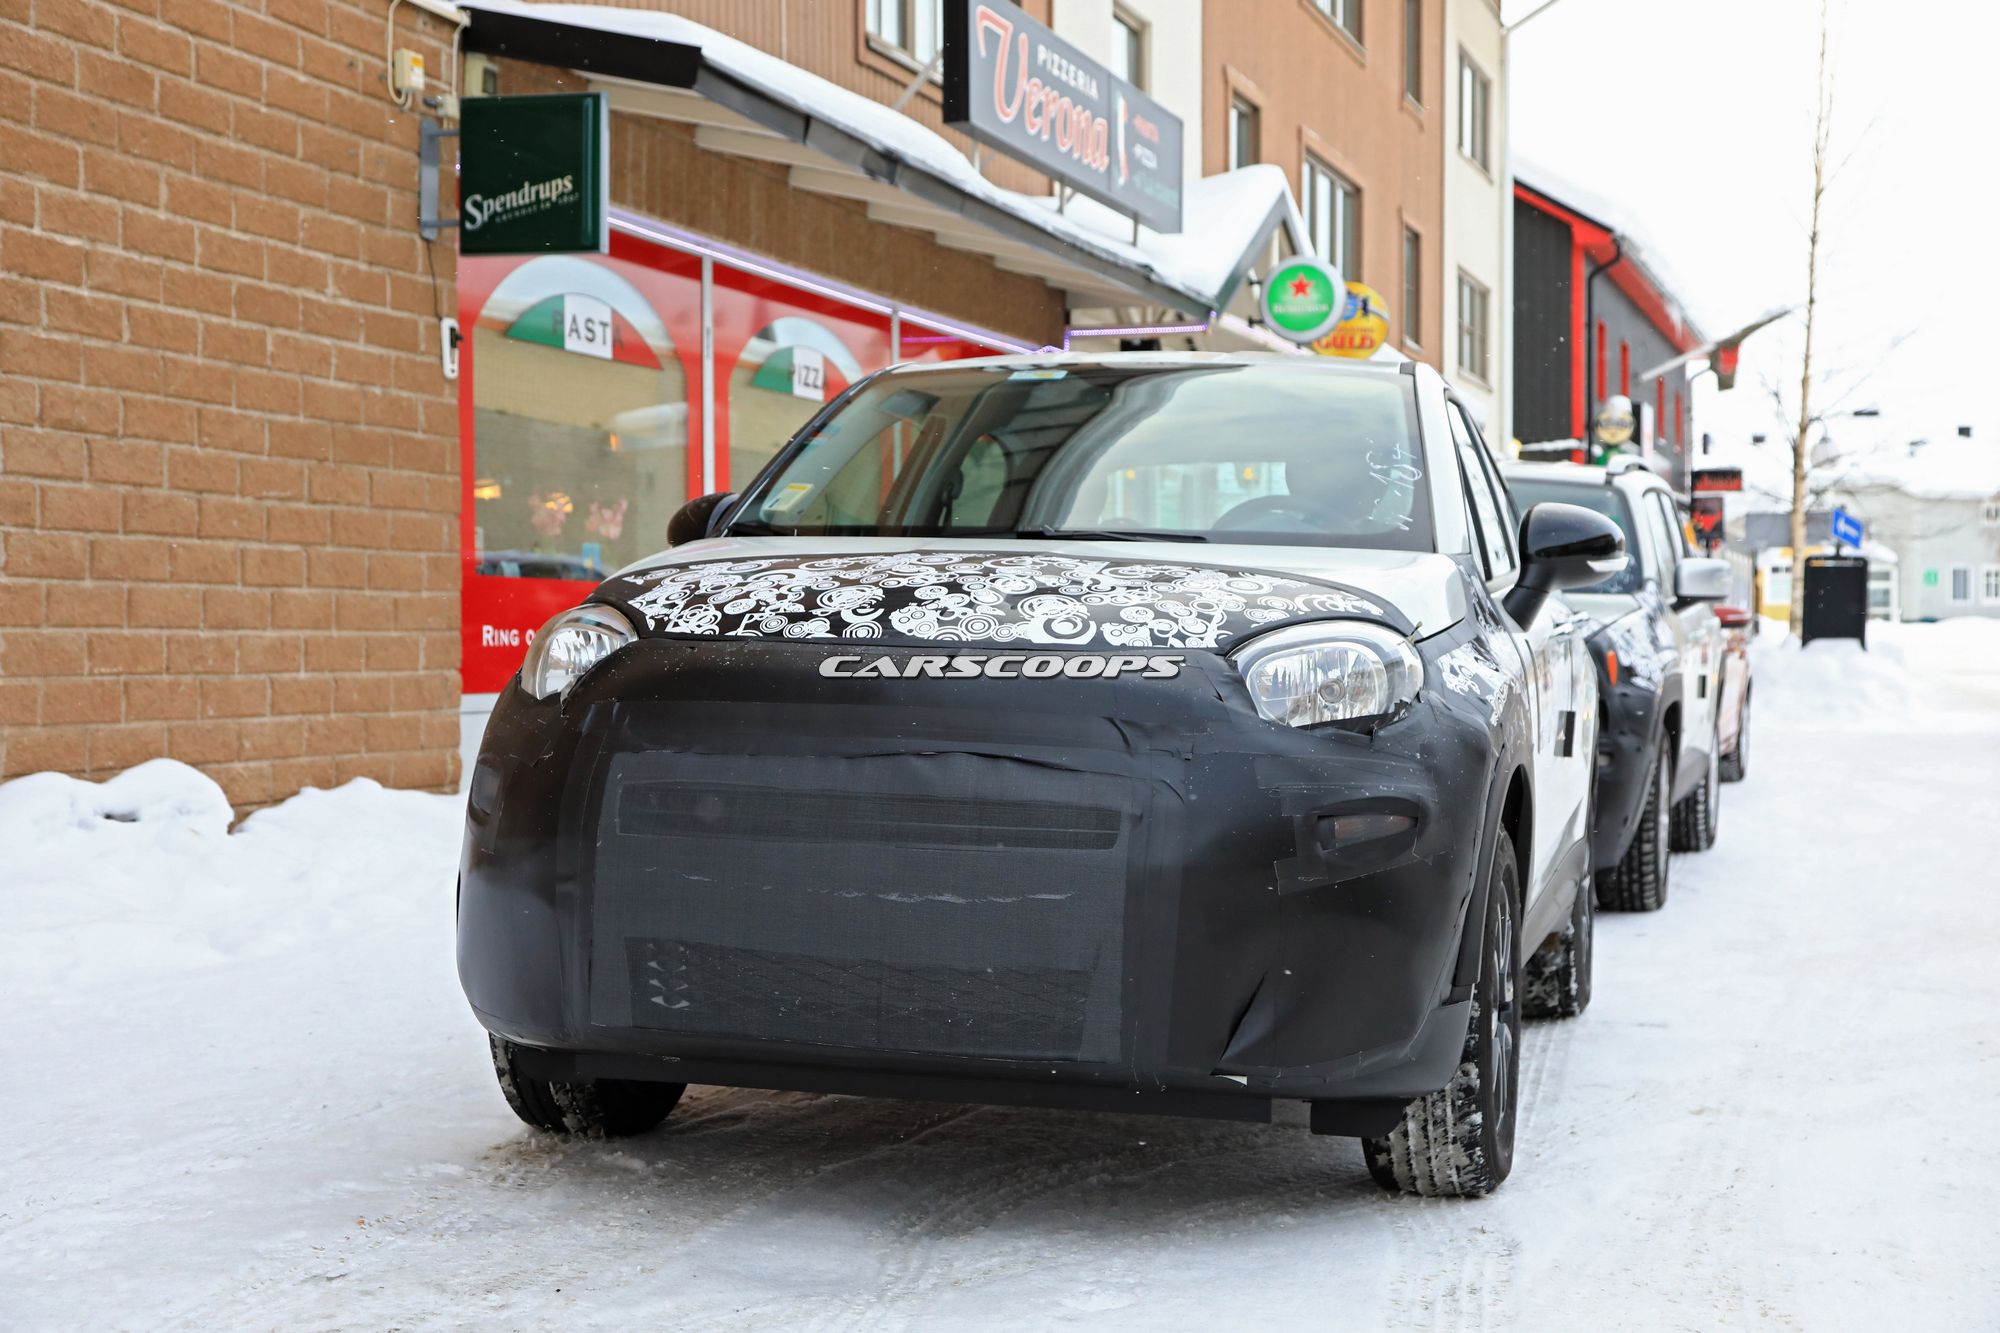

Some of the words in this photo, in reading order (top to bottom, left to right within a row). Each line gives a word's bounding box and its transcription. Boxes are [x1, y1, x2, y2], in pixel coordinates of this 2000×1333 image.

[976, 4, 1110, 173] Verona
[1037, 44, 1098, 101] PIZZERIA
[464, 174, 574, 231] Spendrups
